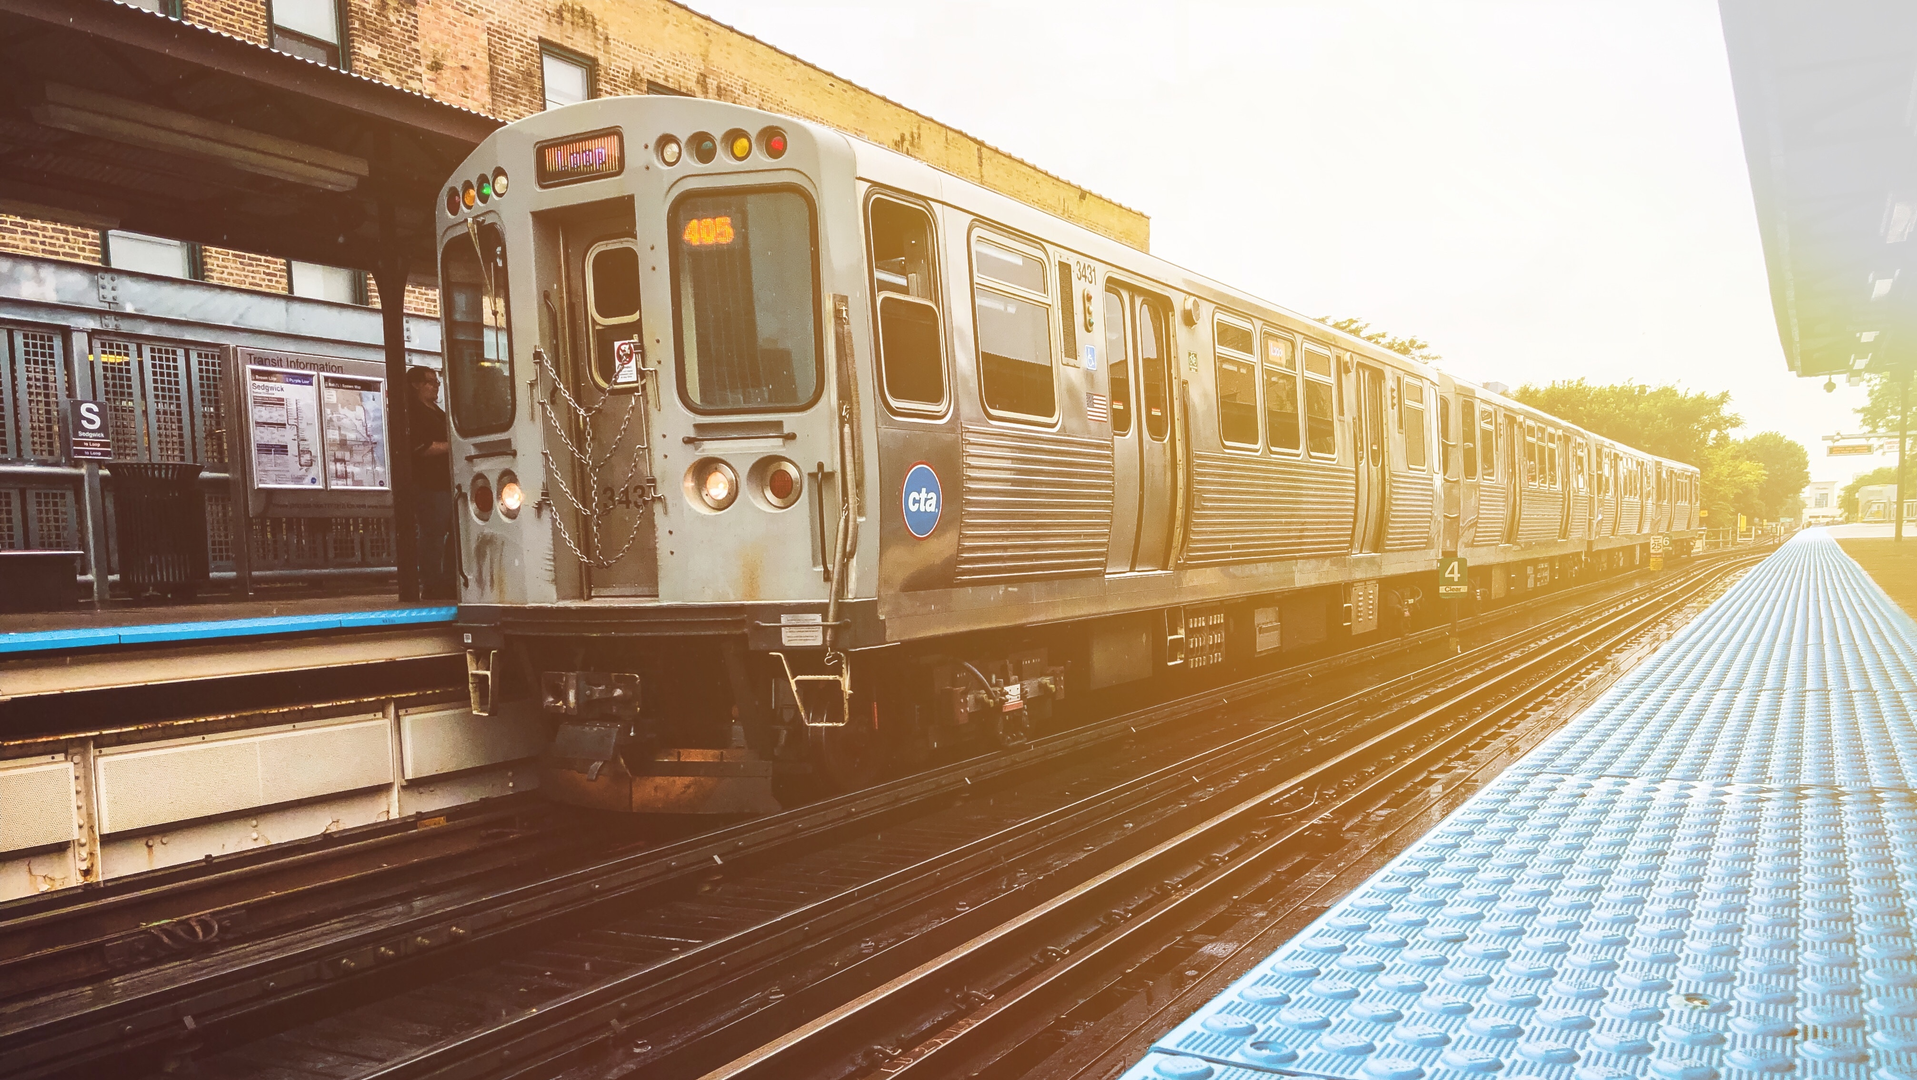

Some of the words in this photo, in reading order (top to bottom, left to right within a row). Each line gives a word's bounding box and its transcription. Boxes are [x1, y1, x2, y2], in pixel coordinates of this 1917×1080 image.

[557, 147, 606, 171] Loop
[683, 216, 735, 246] 405
[1076, 261, 1097, 286] 3431
[247, 353, 283, 367] Transit
[286, 357, 344, 373] Information
[252, 383, 284, 391] Sedgwick
[80, 402, 101, 430] S
[908, 487, 937, 512] cta
[1651, 542, 1662, 550] 25
[1663, 536, 1670, 546] 6
[1445, 561, 1461, 582] 4
